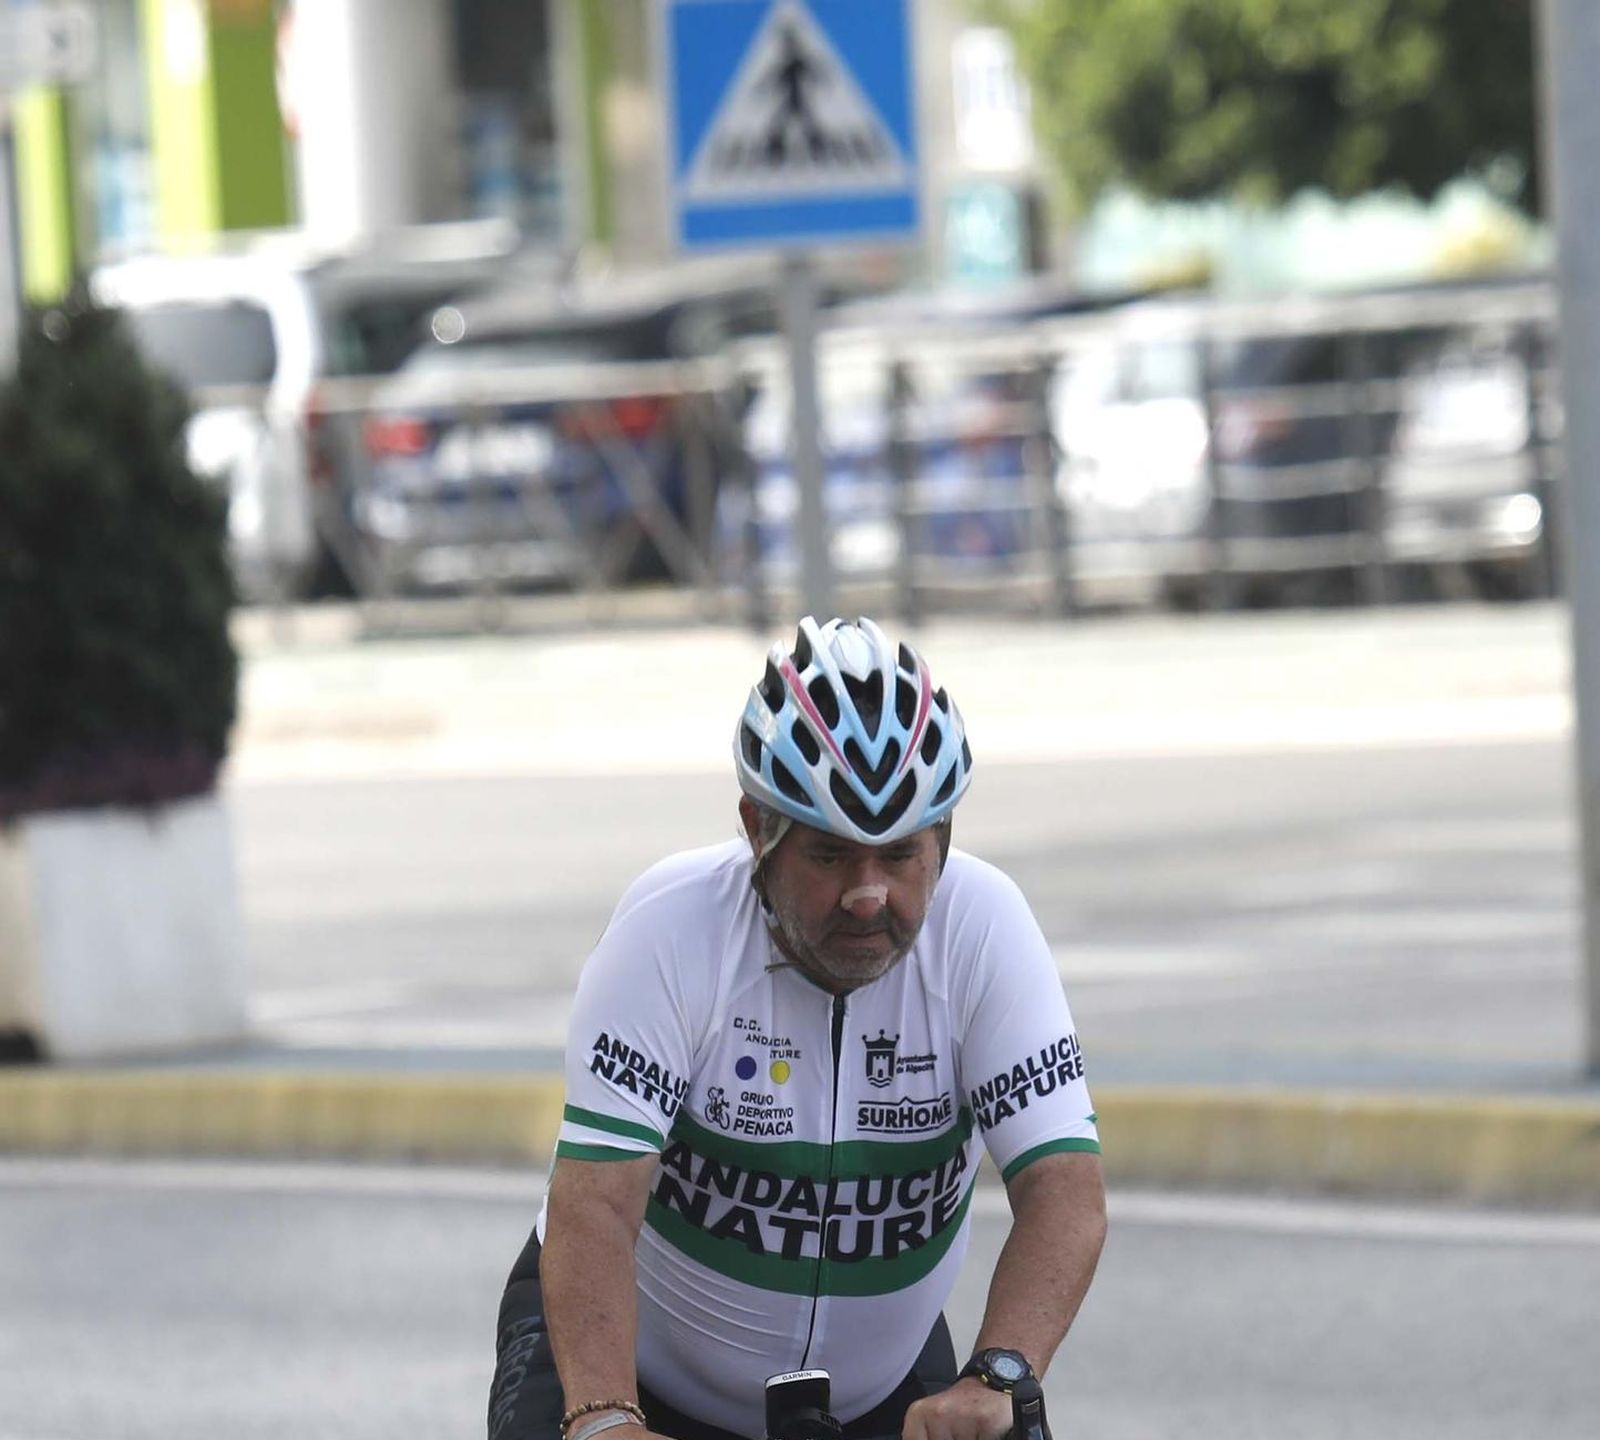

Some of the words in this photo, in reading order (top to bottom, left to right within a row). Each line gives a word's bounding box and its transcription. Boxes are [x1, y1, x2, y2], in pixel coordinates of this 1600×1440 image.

[733, 1017, 761, 1032] C.C.
[592, 1032, 690, 1104] ANDALU
[769, 1050, 802, 1059] TURE
[976, 1055, 1084, 1134] NATURE
[733, 1119, 794, 1137] PENACA
[857, 1098, 952, 1129] SURHOME
[659, 1140, 968, 1217] ANDALUCIA
[654, 1171, 962, 1264] NATURE
[782, 1372, 813, 1382] GARMIN
